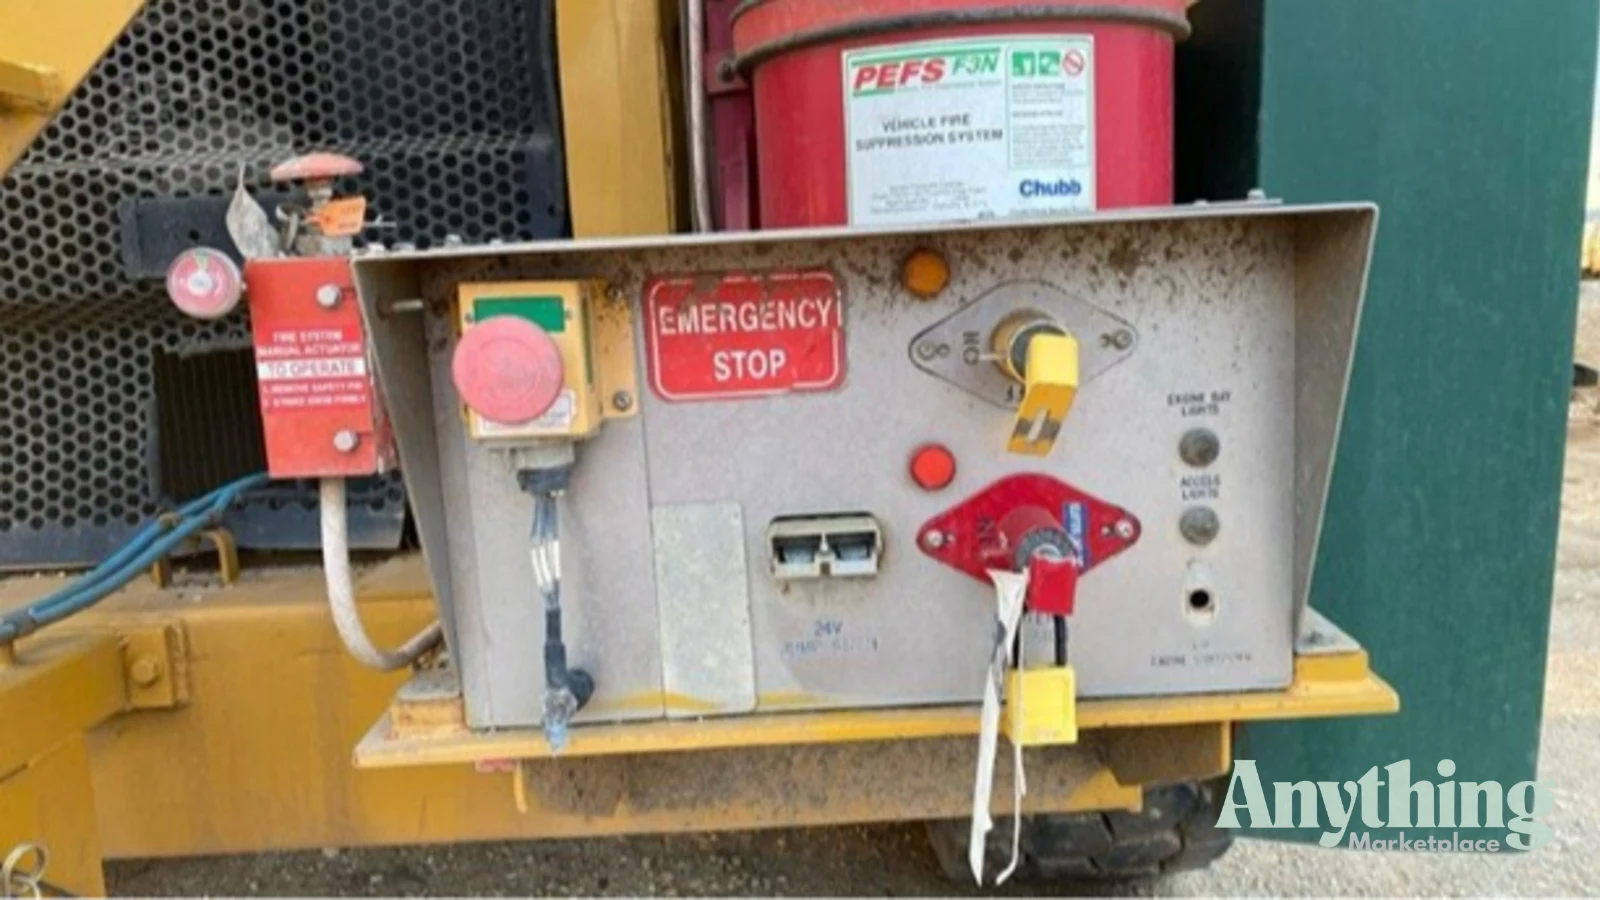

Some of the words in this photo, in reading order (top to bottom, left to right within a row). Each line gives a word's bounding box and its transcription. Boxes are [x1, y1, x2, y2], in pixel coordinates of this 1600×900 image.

[853, 58, 946, 91] PEFS
[881, 116, 936, 132] VEHICLE
[940, 113, 971, 126] FIRE
[855, 131, 945, 151] SUPPRESSION
[947, 128, 1003, 144] SYSTEM
[1019, 179, 1082, 197] Chubb
[658, 299, 834, 335] EMERGENCY
[290, 361, 355, 375] OPERATE
[713, 348, 787, 382] STOP
